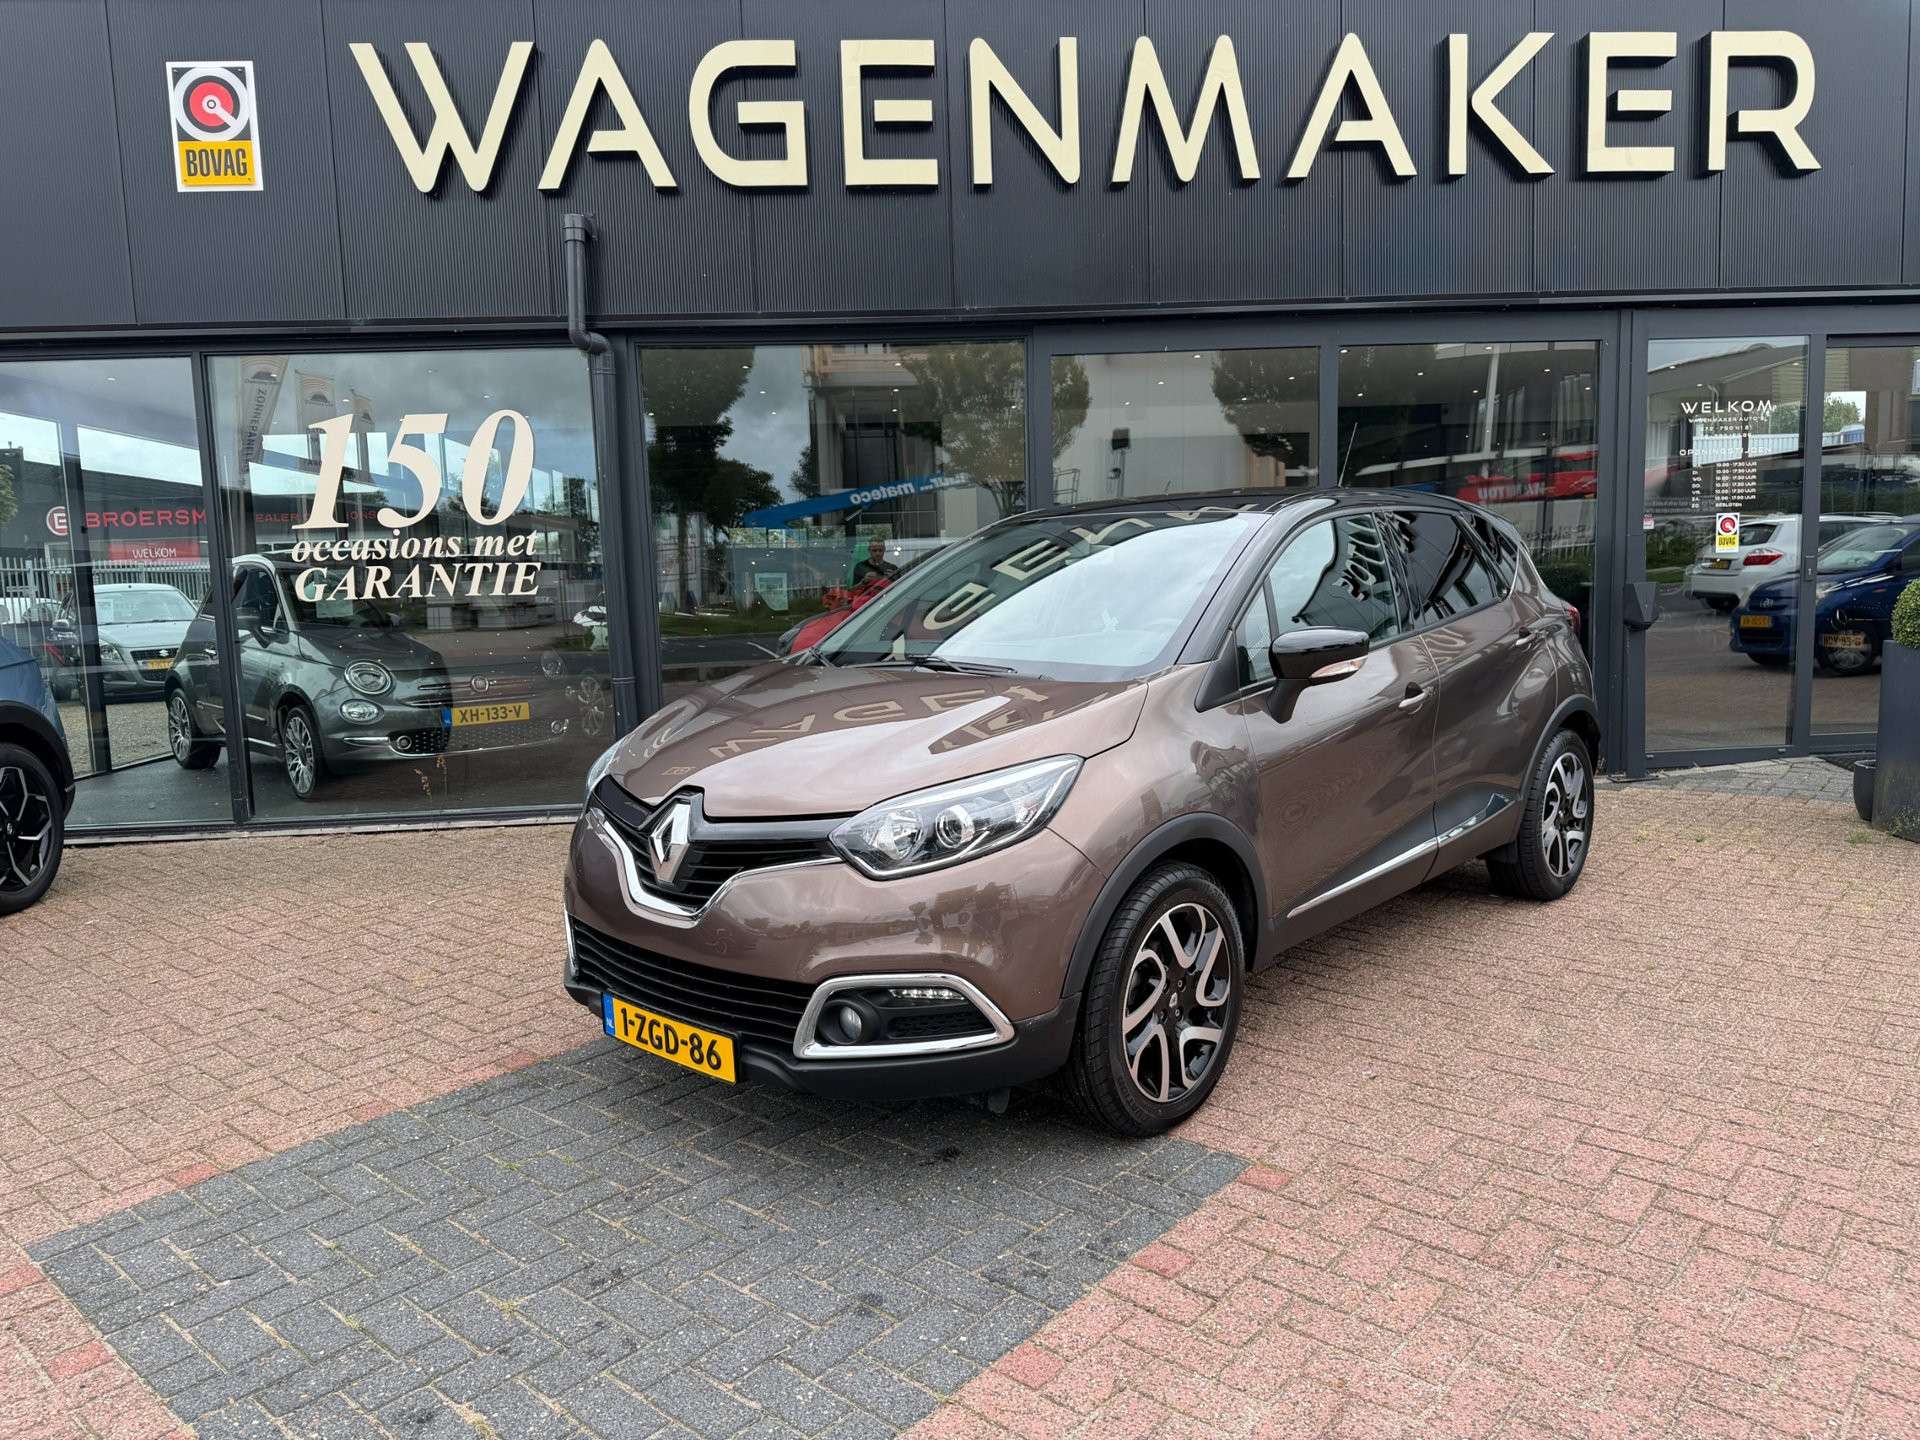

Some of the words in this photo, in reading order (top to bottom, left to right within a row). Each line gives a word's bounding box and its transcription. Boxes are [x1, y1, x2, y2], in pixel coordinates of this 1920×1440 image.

[349, 31, 1822, 193] WAGENMAKER
[185, 148, 248, 177] BOVAG
[1681, 399, 1772, 414] WELKOM
[291, 409, 535, 530] 150
[85, 508, 207, 528] BROERSM
[132, 547, 177, 559] WELKOM
[291, 528, 462, 563] occasions
[473, 530, 538, 557] met
[294, 562, 542, 602] GARANTIE
[459, 705, 522, 723] XH-133-V
[621, 1008, 722, 1070] 1-ZGD-86
